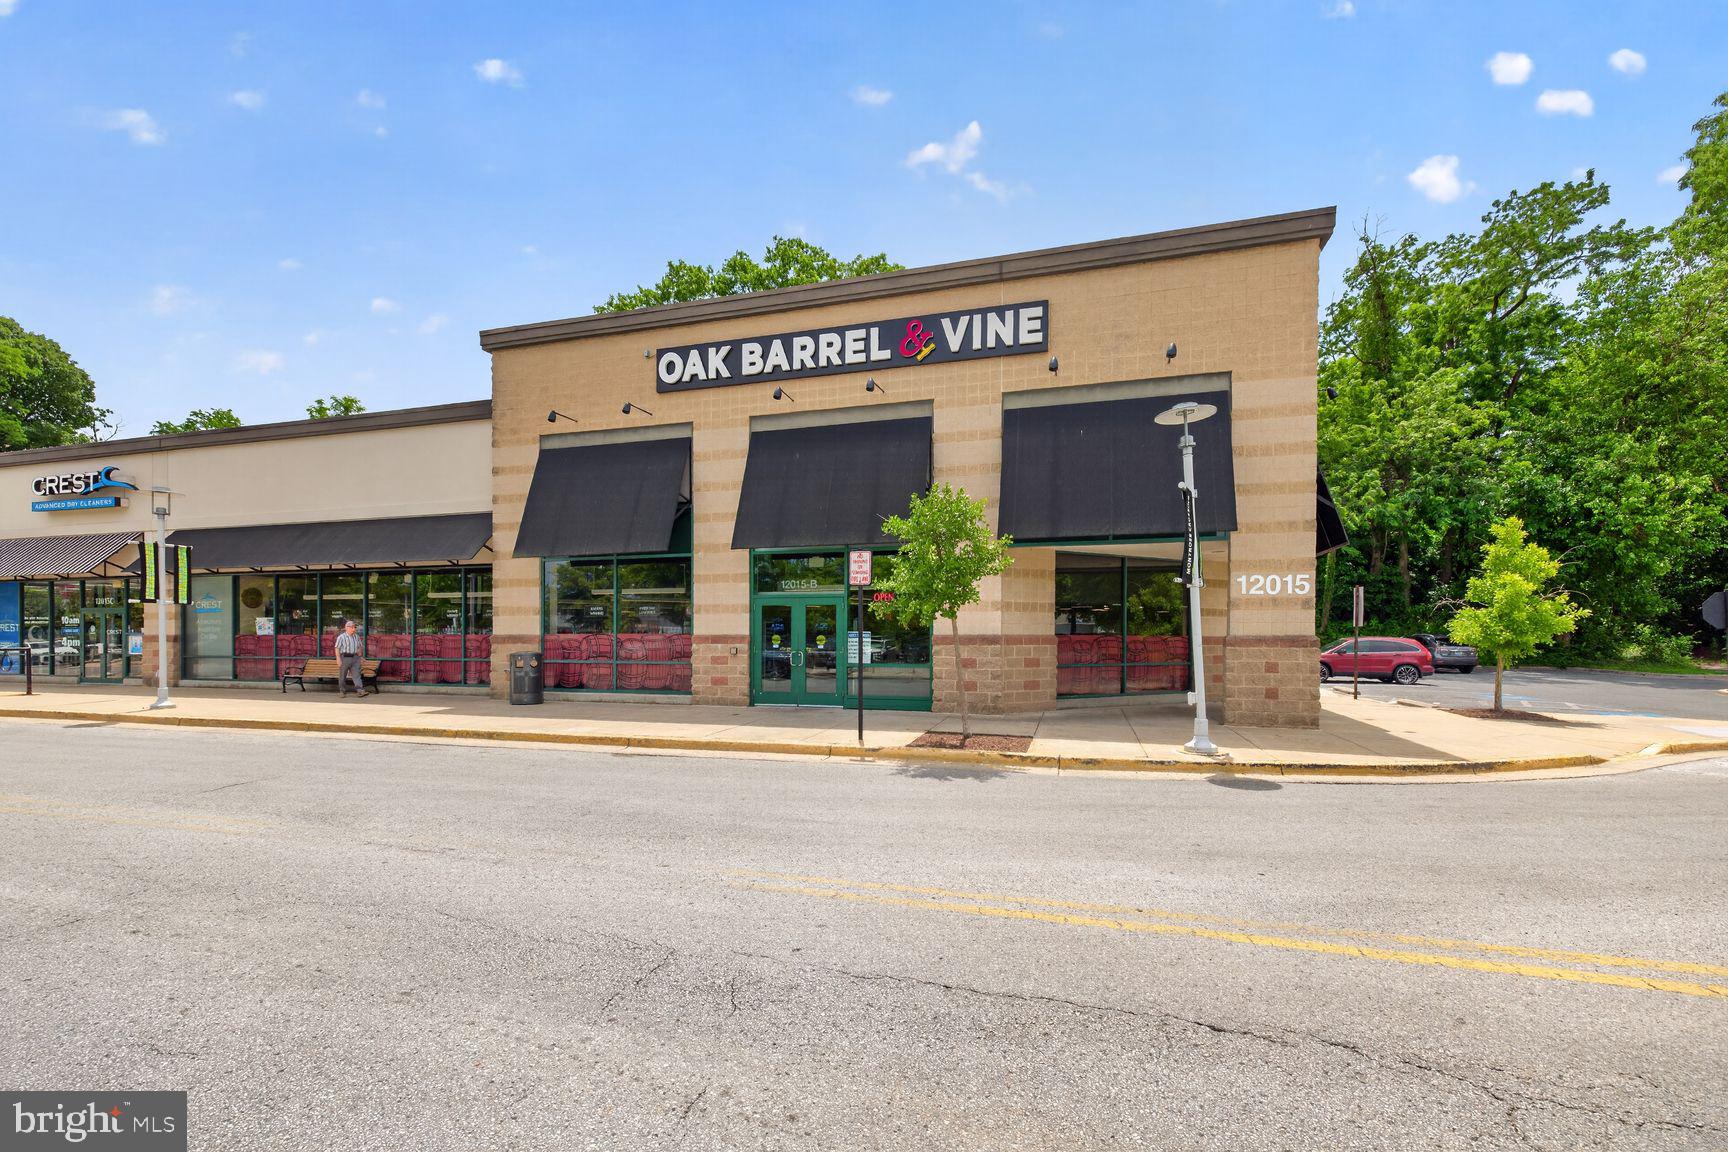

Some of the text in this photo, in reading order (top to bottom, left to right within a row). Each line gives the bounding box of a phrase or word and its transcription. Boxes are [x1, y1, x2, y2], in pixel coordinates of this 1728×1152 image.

[658, 305, 1043, 385] OAK BARREL & VINE
[32, 472, 99, 496] CREST
[34, 501, 66, 510] ADVANCED
[79, 499, 112, 508] CLEANERS
[781, 579, 818, 589] 12015-B
[1236, 574, 1311, 595] 12015
[873, 592, 895, 602] OPEN
[195, 600, 222, 609] CREST
[61, 616, 80, 624] 10am
[0, 623, 19, 632] REST
[61, 636, 81, 647] 4pm
